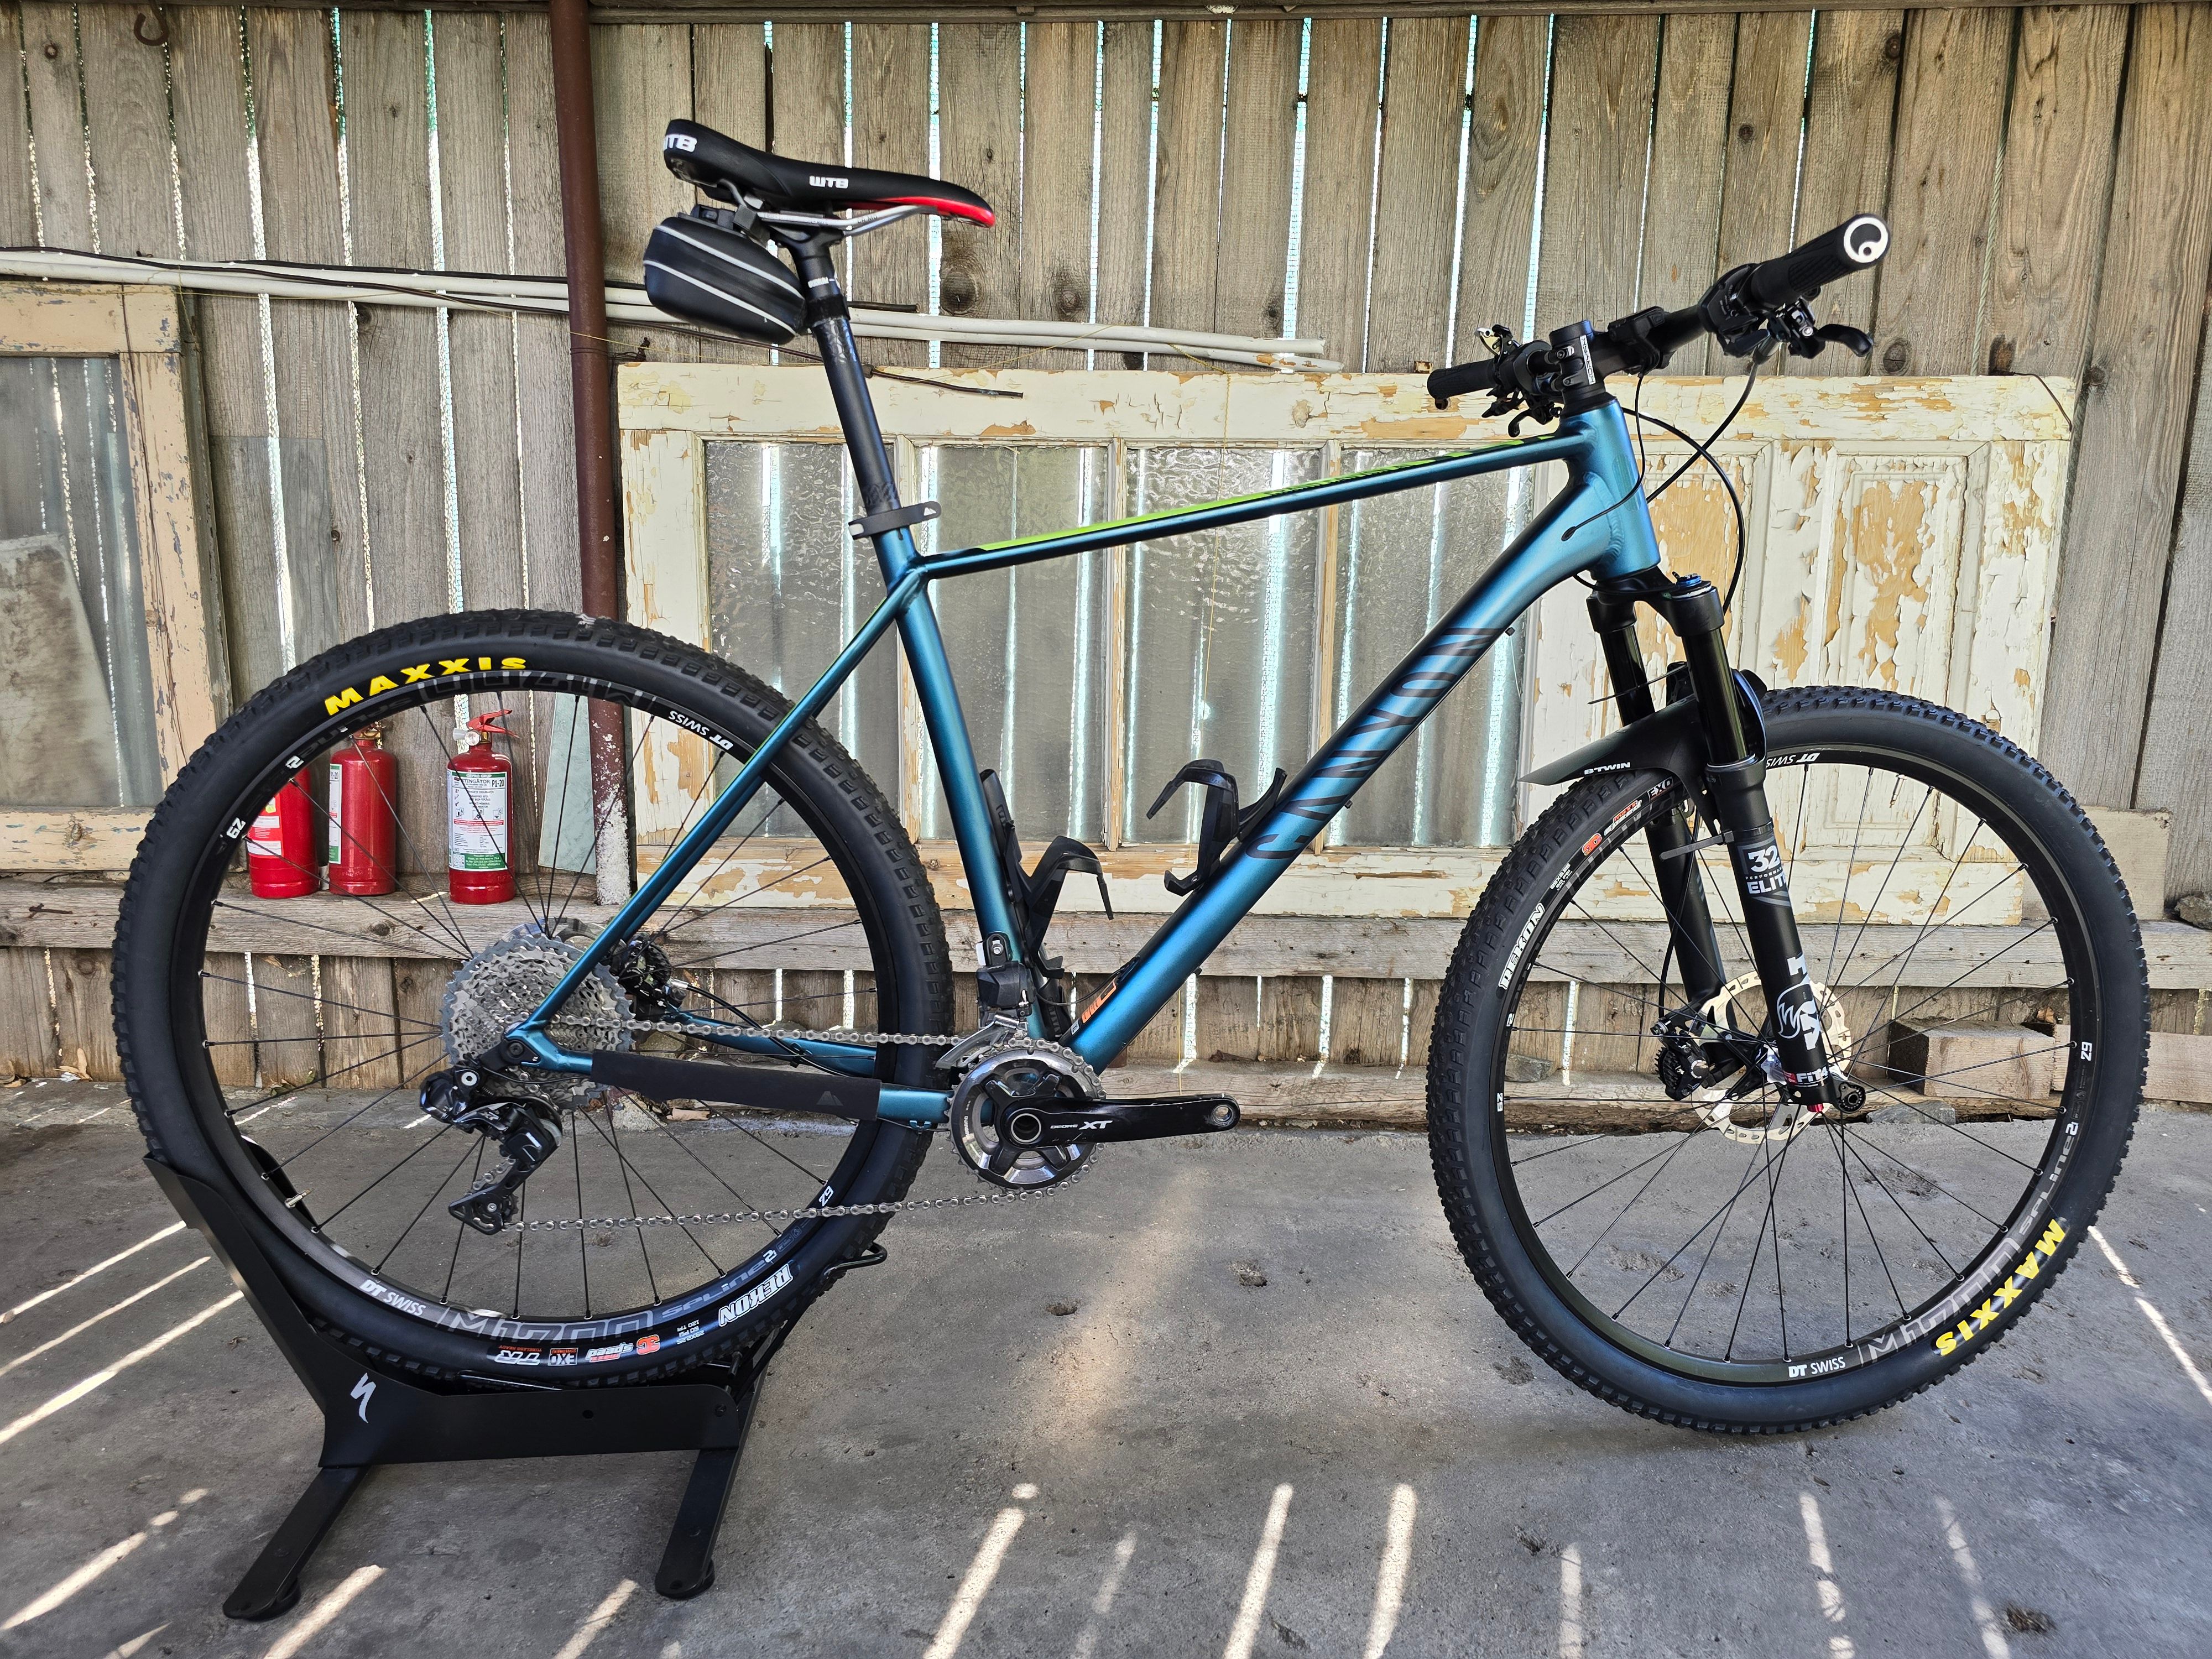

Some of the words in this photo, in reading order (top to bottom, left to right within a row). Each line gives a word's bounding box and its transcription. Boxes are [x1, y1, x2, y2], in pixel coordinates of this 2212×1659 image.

[809, 175, 849, 189] WTB
[324, 656, 526, 716] MAXXIS
[668, 710, 710, 736] SWISS
[709, 734, 734, 750] DT
[1245, 627, 1507, 859] CANYON
[1766, 754, 1794, 767] SWIS
[1794, 752, 1821, 764] DT
[492, 779, 504, 787] P1-20
[1648, 778, 1673, 797] EXO
[226, 817, 246, 839] 29
[1747, 844, 1781, 873] 32
[1498, 903, 1546, 990] REKON
[2080, 1041, 2093, 1061] 29
[1078, 1119, 1113, 1131] XT
[818, 1186, 834, 1207] 29
[359, 1279, 388, 1297] DT
[383, 1291, 427, 1317] SWISS
[718, 1263, 794, 1327] REKON
[1935, 1219, 2067, 1357] MAXXIS
[550, 1353, 578, 1365] EXO
[1788, 1364, 1808, 1379] DT
[1810, 1356, 1846, 1375] SWISS
